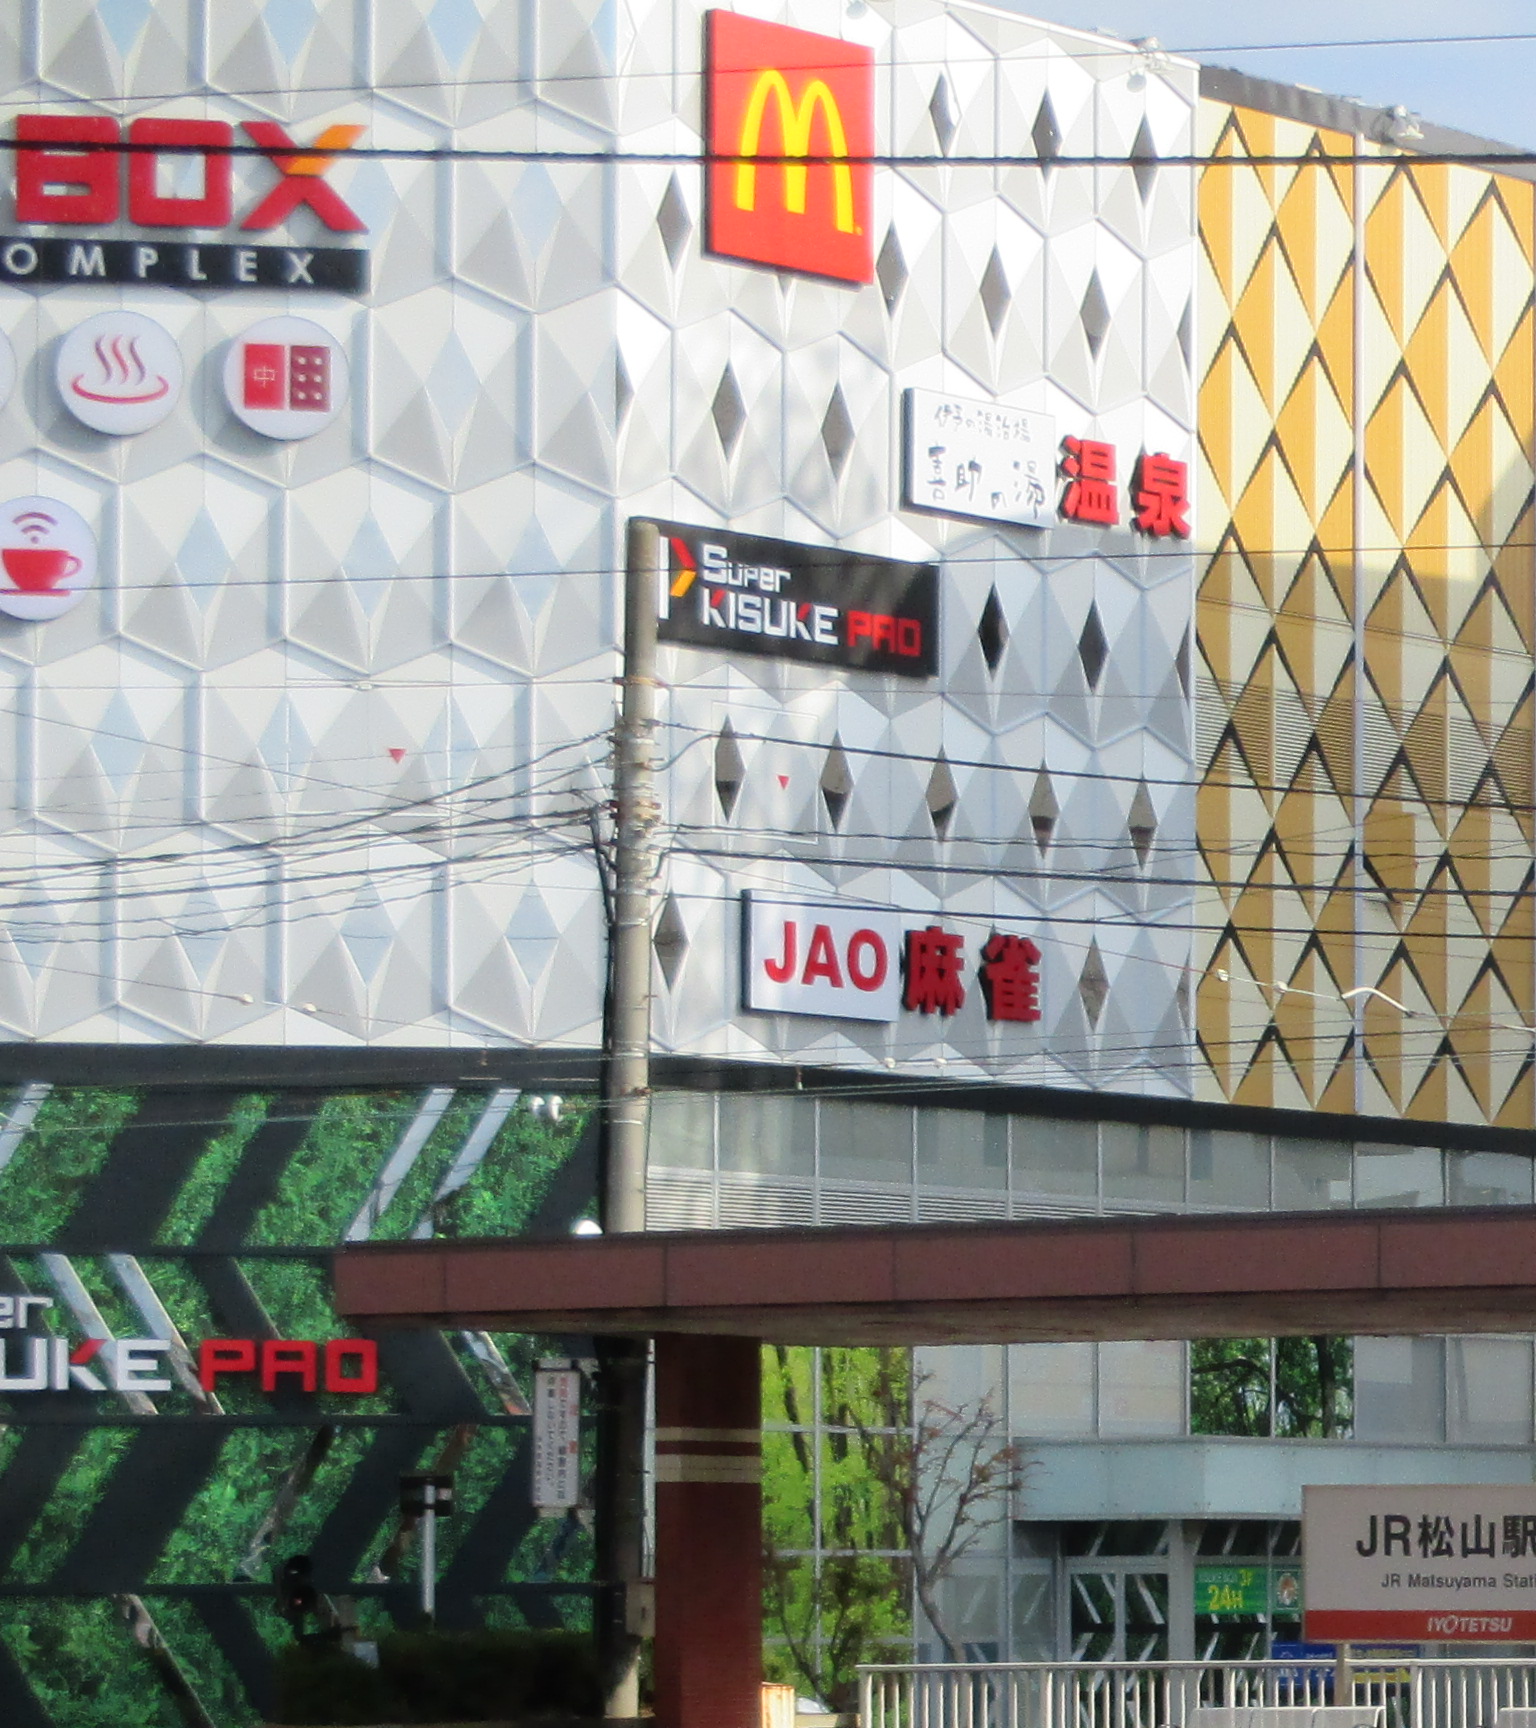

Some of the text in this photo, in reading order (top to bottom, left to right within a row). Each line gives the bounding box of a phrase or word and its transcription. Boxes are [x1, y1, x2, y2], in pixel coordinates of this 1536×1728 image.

[16, 114, 370, 232] BOX
[1060, 434, 1193, 539] 温泉
[702, 544, 791, 592] Super
[702, 586, 839, 645] KISUKE
[764, 920, 1042, 1021] JAO 麻雀
[1381, 1574, 1401, 1588] JR
[1408, 1573, 1497, 1591] Matsuyama
[1427, 1616, 1513, 1633] IYOTETSU
